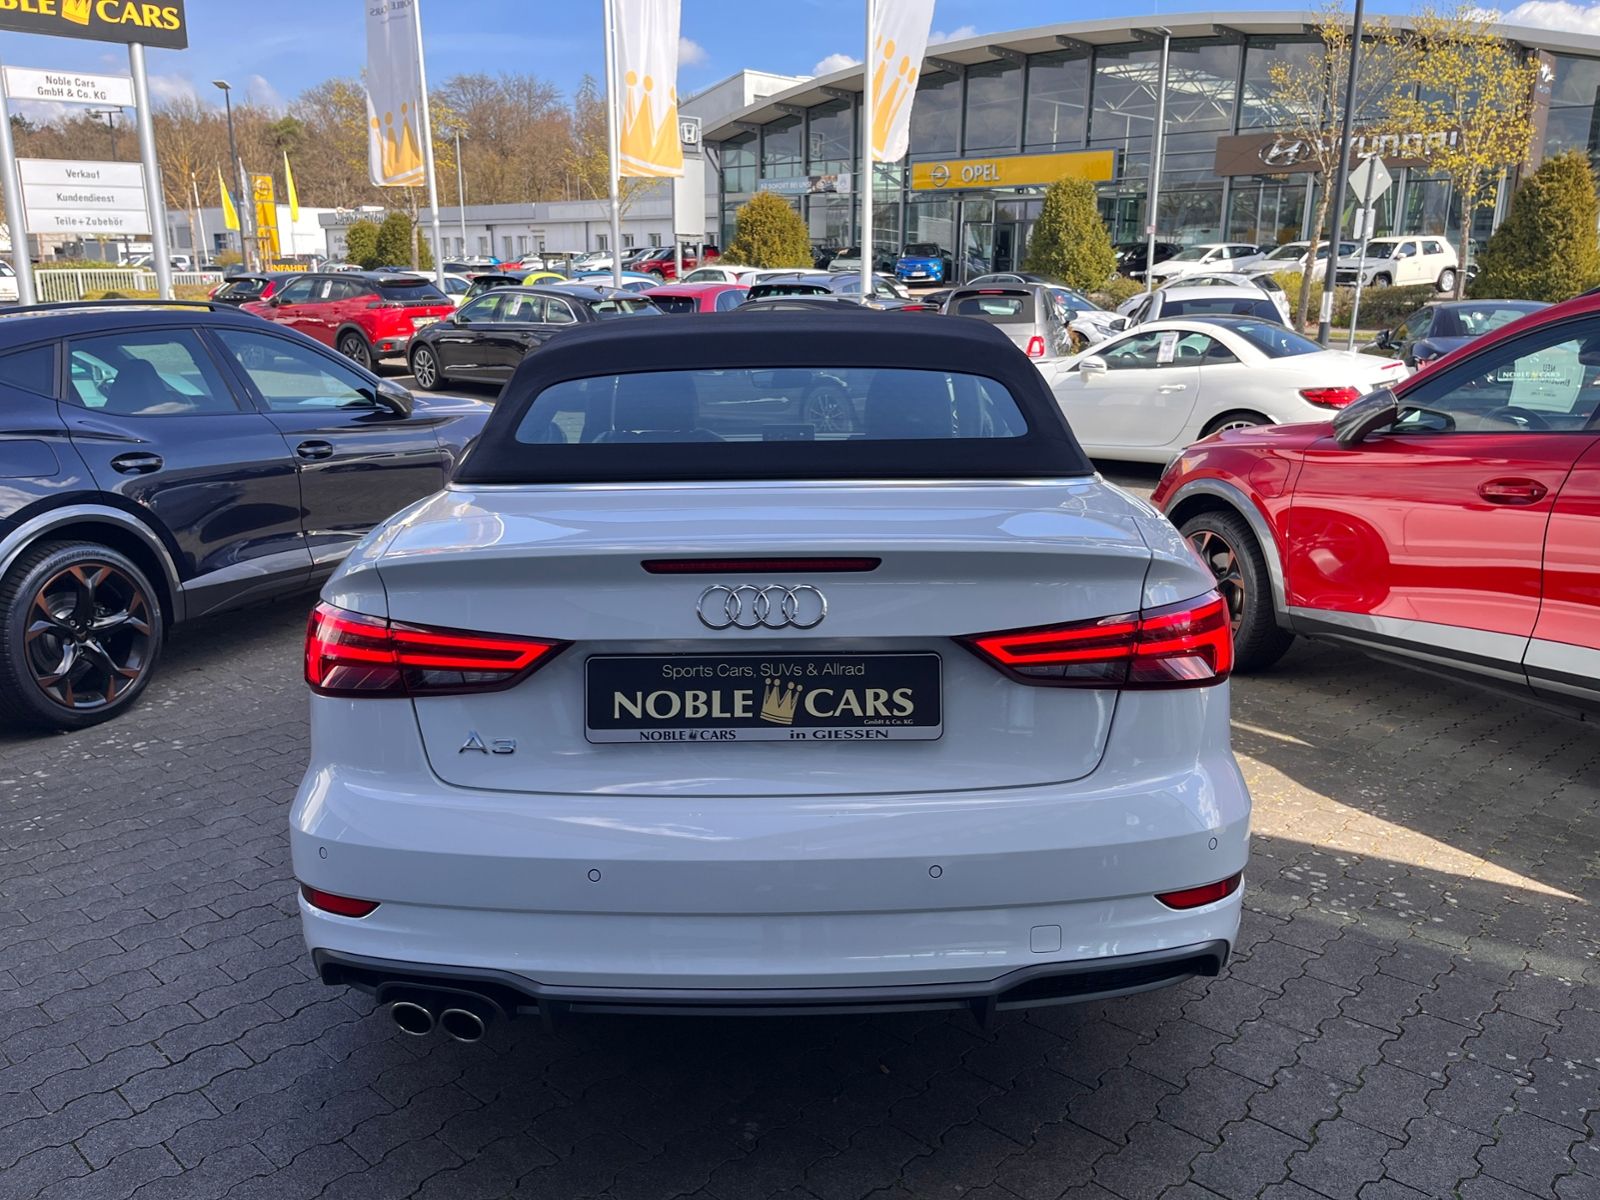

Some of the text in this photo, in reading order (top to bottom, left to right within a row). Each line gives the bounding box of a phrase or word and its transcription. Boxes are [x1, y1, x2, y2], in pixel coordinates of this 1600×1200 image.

[96, 0, 181, 30] CARS
[45, 75, 96, 88] Noble Cars
[37, 87, 107, 100] GmbH & Co. KG
[65, 169, 101, 179] Verkauf
[961, 163, 1000, 182] OPEL
[56, 193, 115, 203] Kundendienst
[662, 663, 865, 680] Sports Cars, SUVs & Allrad
[613, 687, 914, 719] NOBLE CARS
[458, 729, 517, 755] A3
[640, 730, 889, 741] NOBLE CARS in GIESSEN
